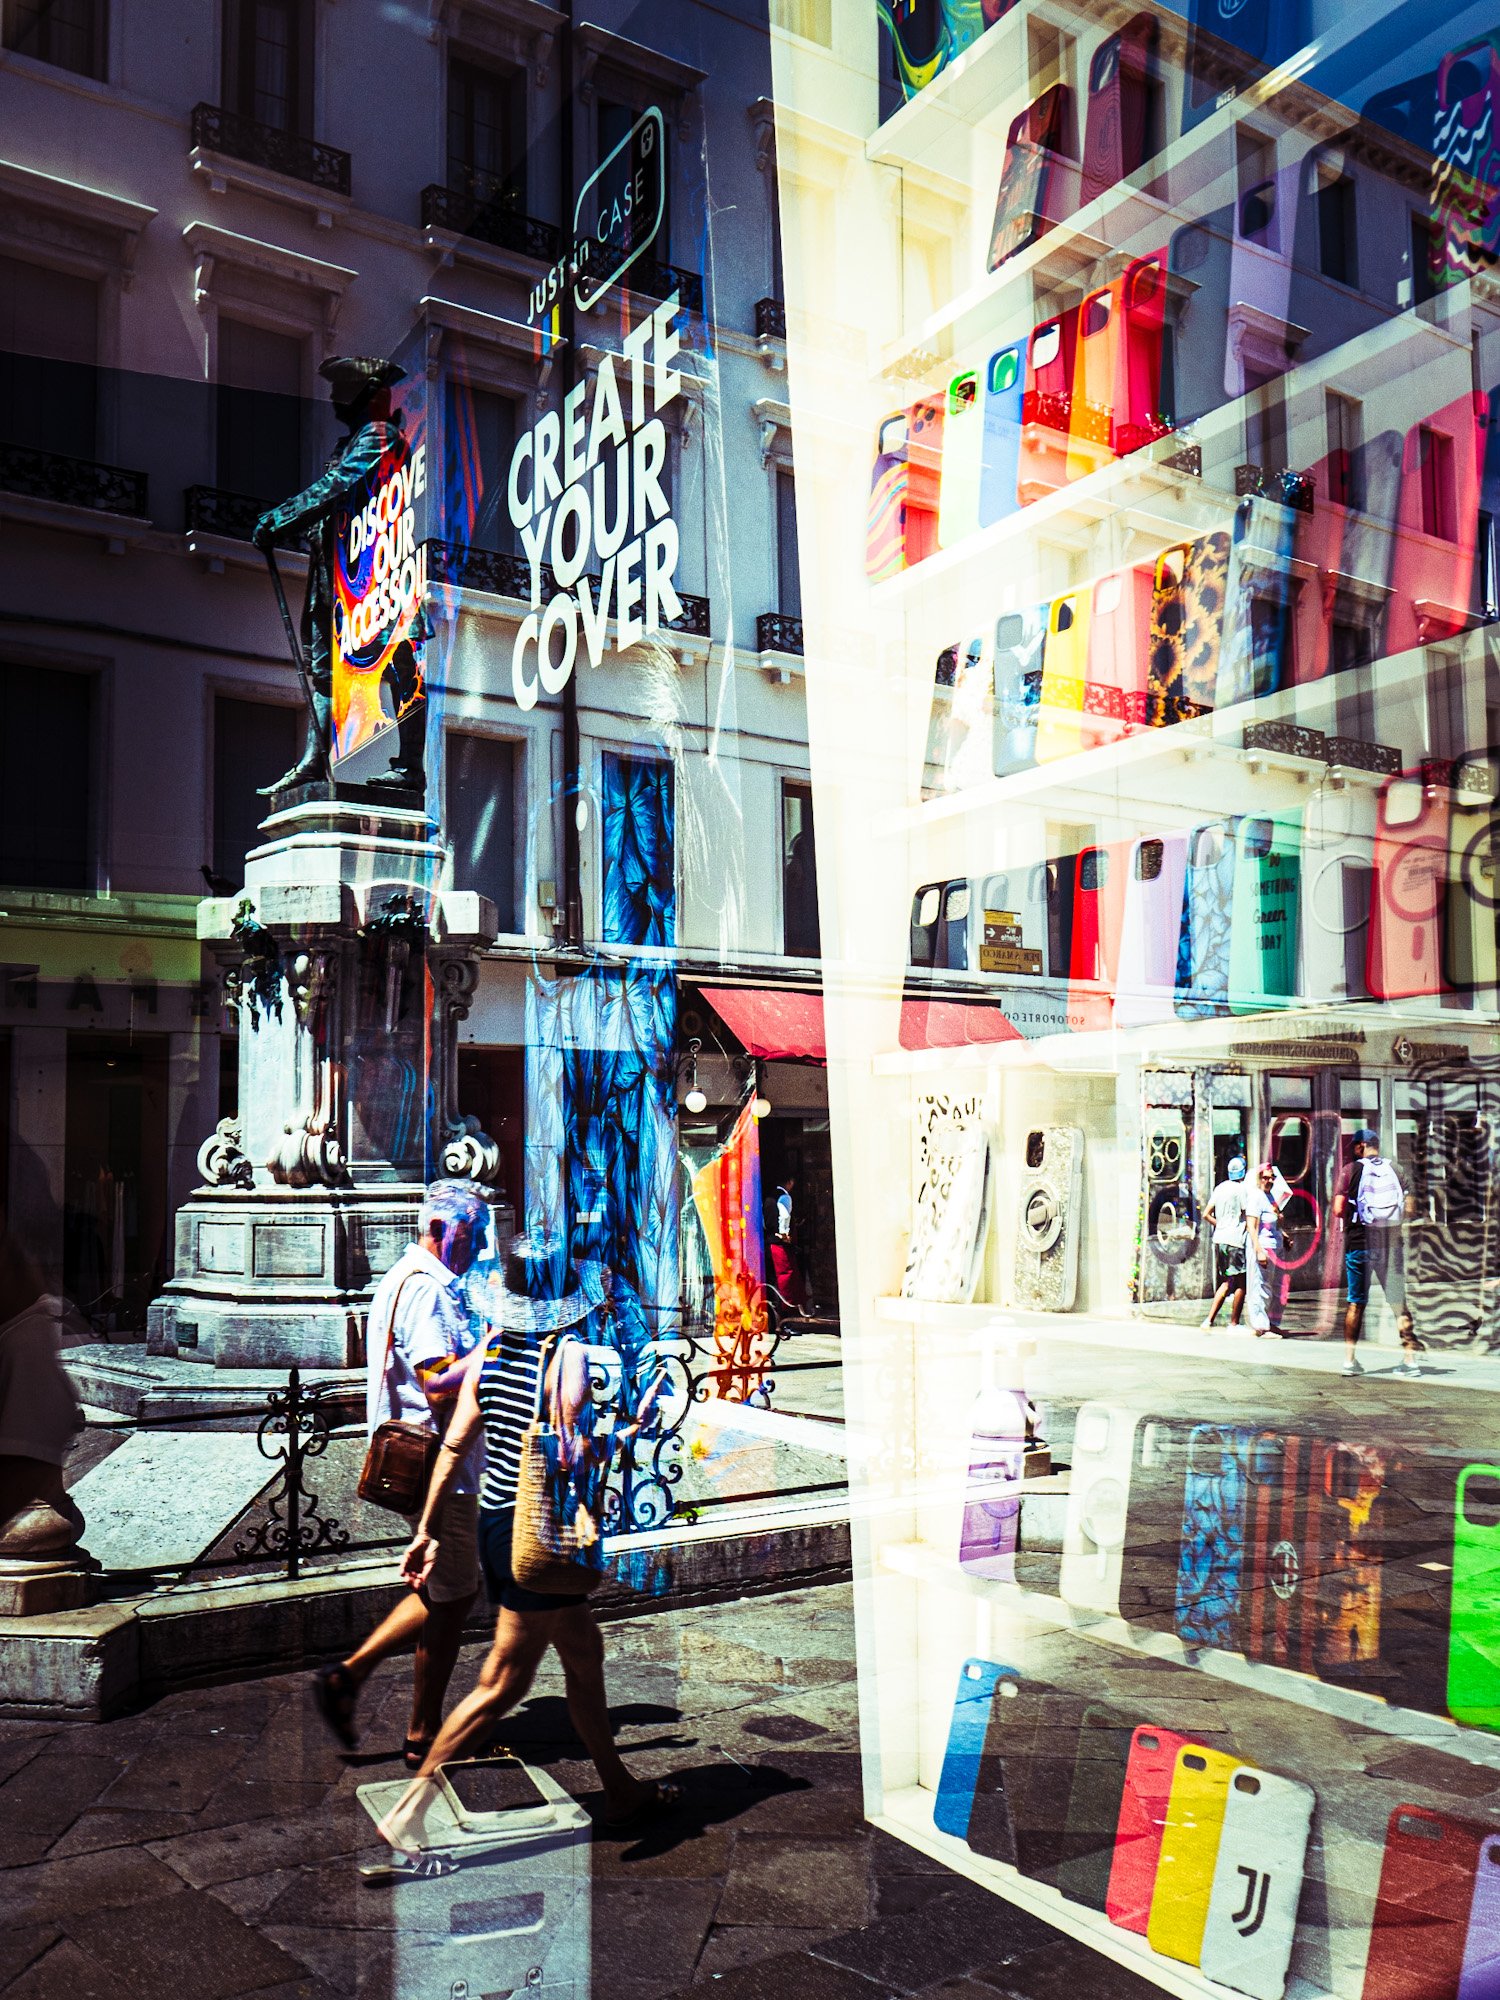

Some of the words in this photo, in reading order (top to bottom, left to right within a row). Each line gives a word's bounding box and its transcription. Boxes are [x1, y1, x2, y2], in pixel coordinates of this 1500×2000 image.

[526, 256, 567, 325] JUST
[573, 240, 589, 268] in
[597, 167, 645, 243] CASE
[508, 288, 681, 529] CREATE
[350, 443, 428, 563] DISCOVE
[373, 507, 416, 584] OUR
[519, 418, 671, 611] YOUR
[511, 516, 684, 712] COVER
[1250, 878, 1295, 897] SOMETHING
[1269, 852, 1281, 868] DO
[1255, 935, 1282, 951] TODAY
